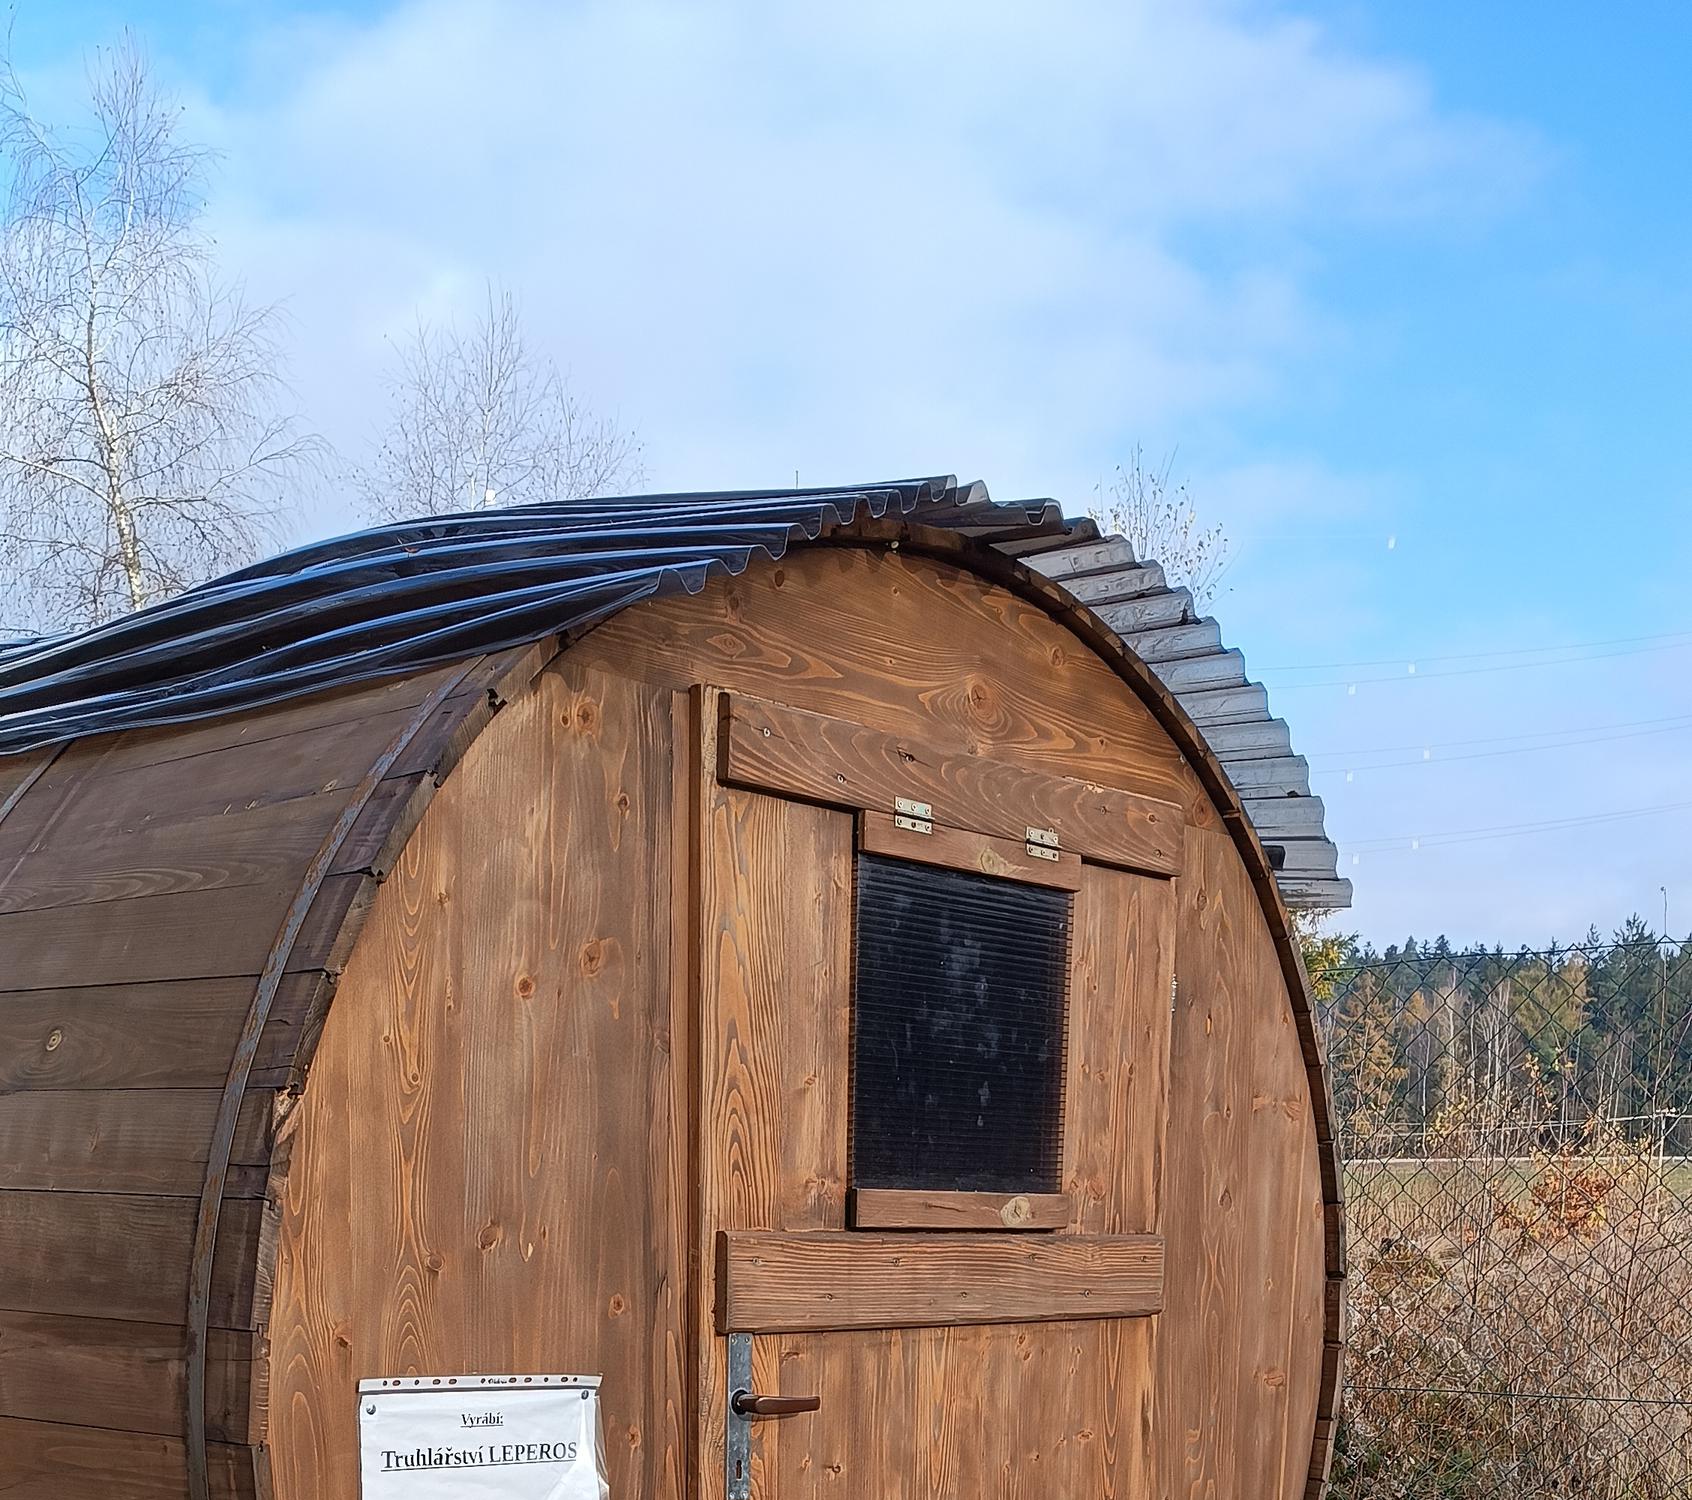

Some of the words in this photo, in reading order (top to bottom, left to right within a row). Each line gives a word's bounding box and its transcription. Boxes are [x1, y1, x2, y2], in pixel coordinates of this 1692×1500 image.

[461, 1412, 504, 1428] Vyrábí:
[381, 1444, 483, 1470] Truhlářství
[488, 1442, 577, 1464] LEPEROS
